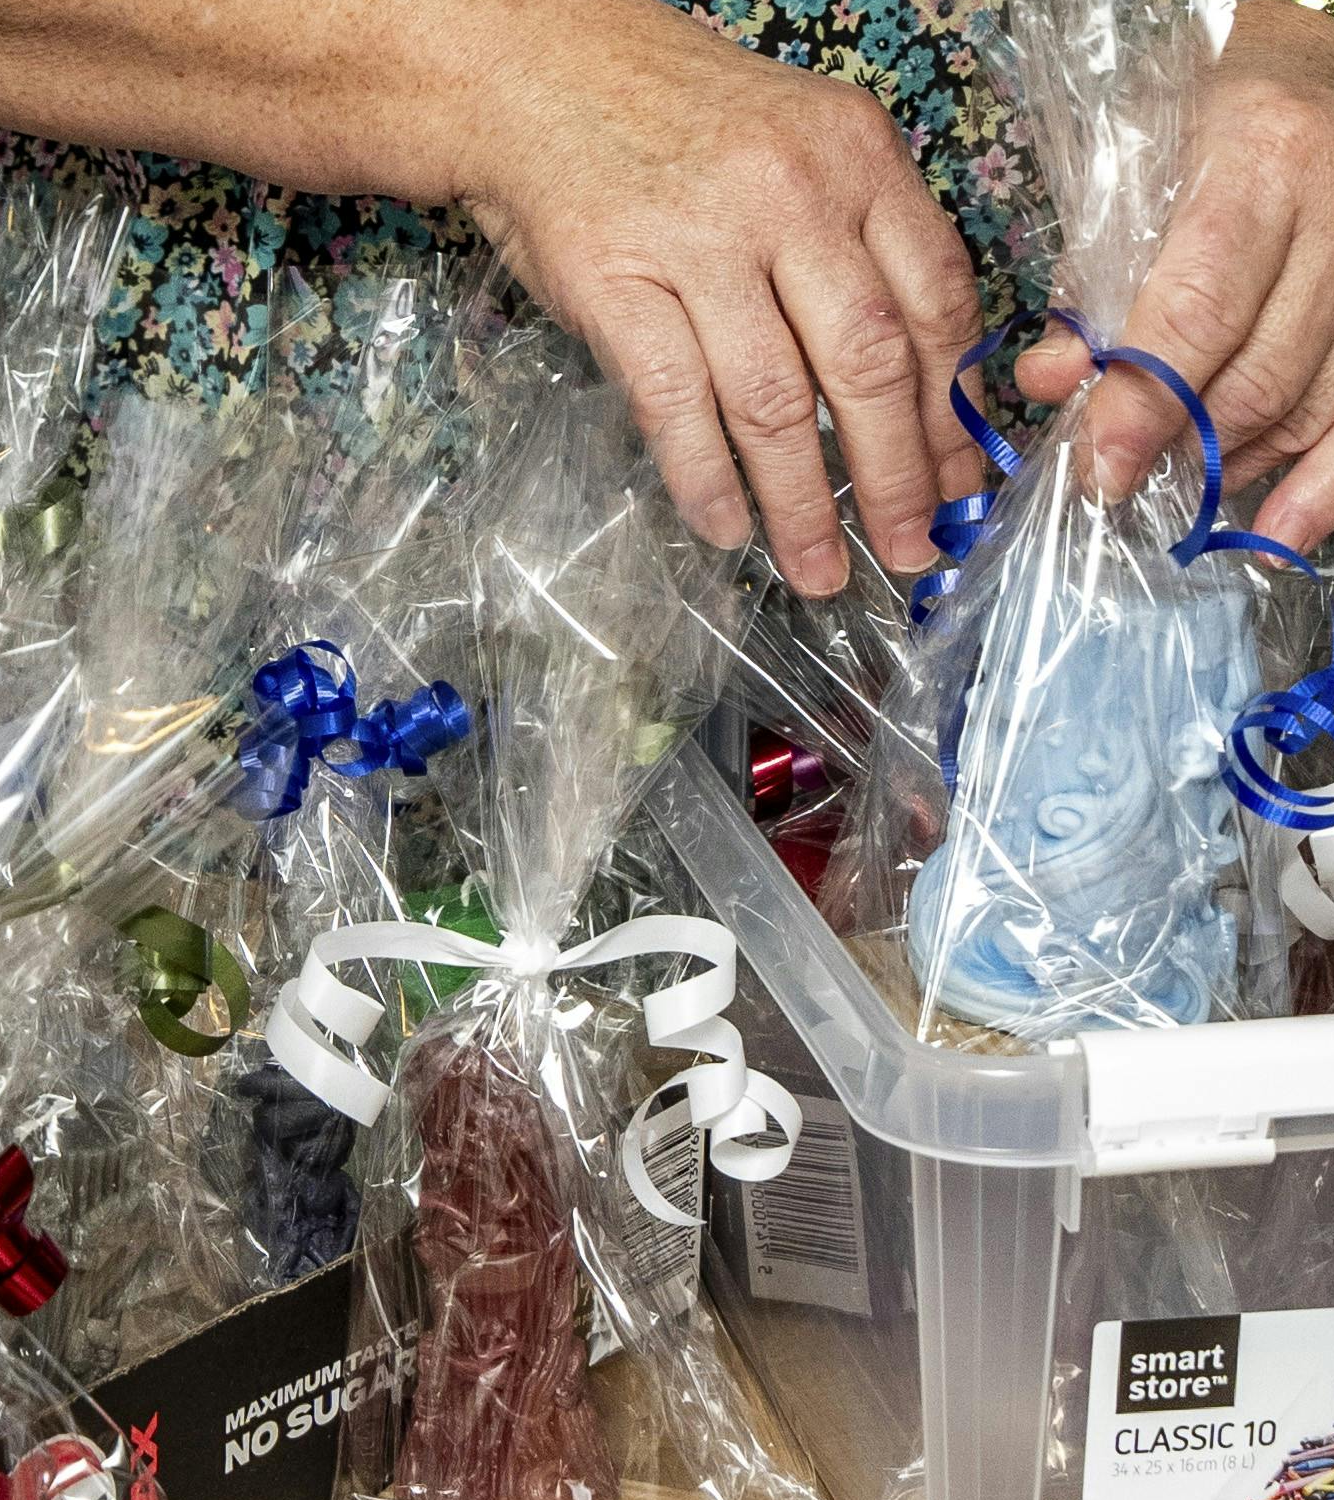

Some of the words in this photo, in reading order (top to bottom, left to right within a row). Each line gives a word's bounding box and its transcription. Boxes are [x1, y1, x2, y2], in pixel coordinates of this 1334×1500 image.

[1129, 1343, 1225, 1374] smart
[224, 1359, 342, 1435] MAXIMUM
[224, 1420, 279, 1475] NO
[1114, 1422, 1236, 1456] CLASSIC
[1243, 1419, 1278, 1448] 10
[1112, 1460, 1130, 1478] 34
[1145, 1459, 1164, 1476] 25
